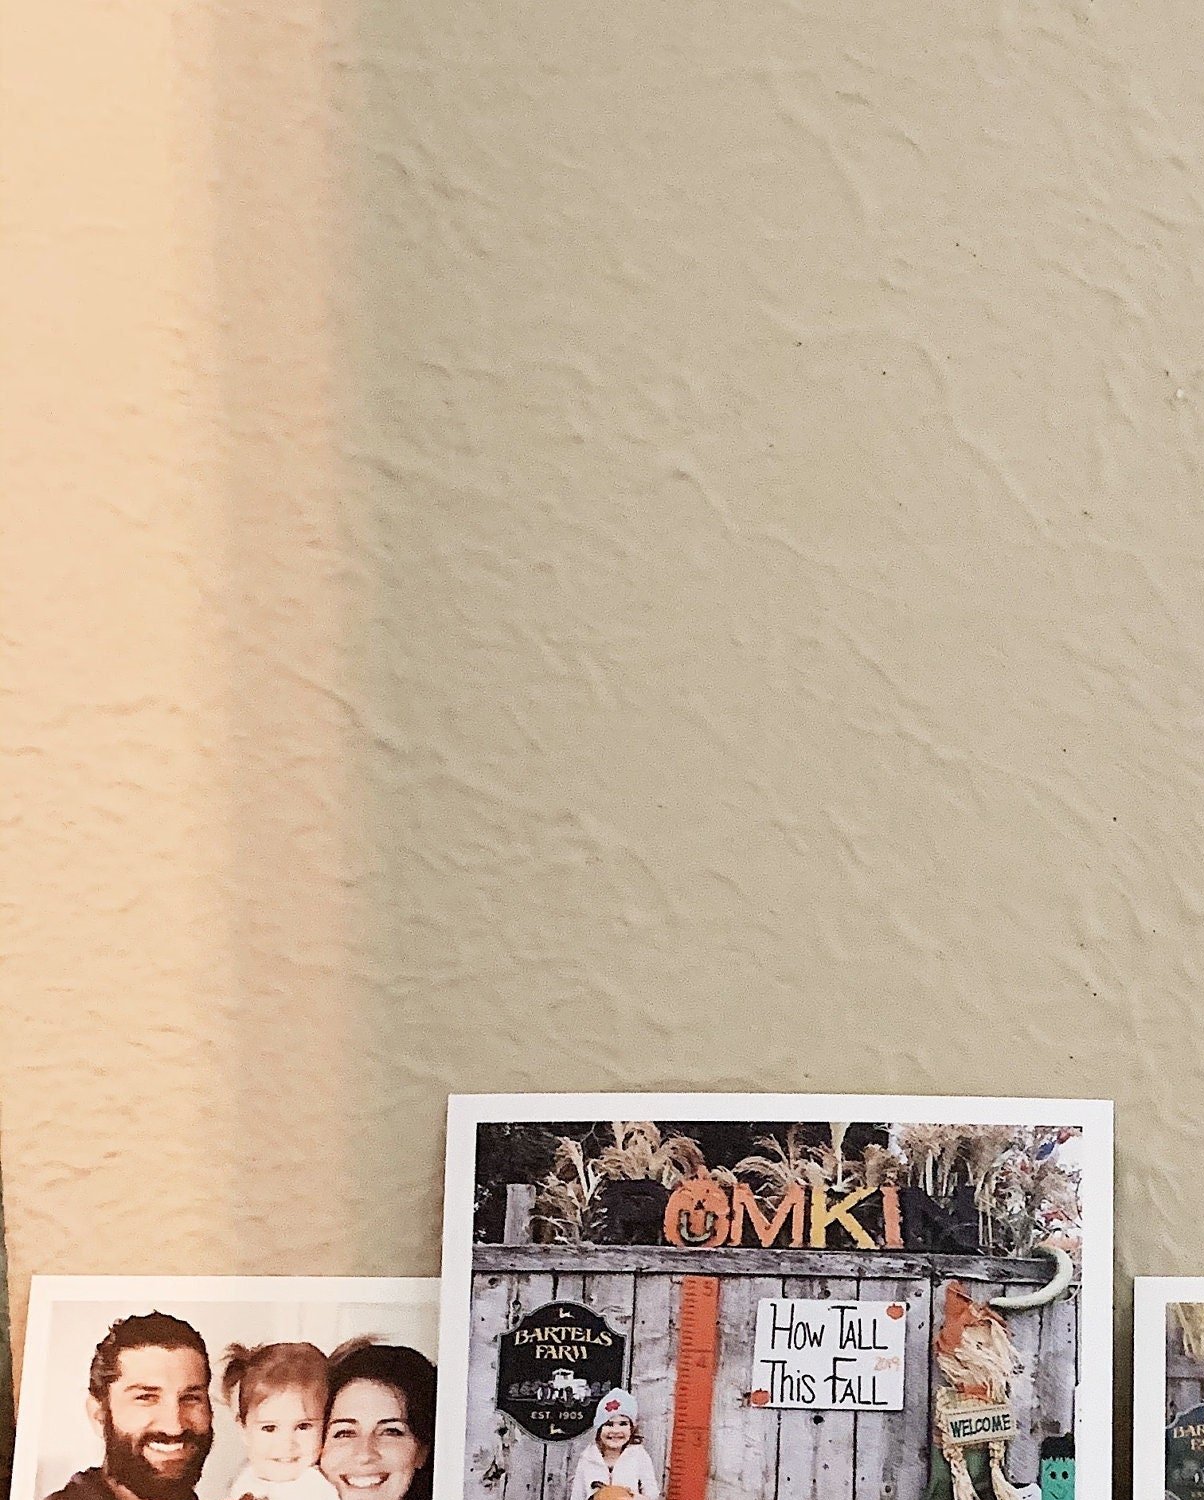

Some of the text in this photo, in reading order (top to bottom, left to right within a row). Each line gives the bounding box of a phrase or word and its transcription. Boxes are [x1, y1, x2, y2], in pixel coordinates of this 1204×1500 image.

[514, 1326, 613, 1347] BARTELS
[769, 1303, 889, 1351] How TALL
[535, 1345, 589, 1363] FARM
[760, 1356, 889, 1405] This FALL
[949, 1413, 1012, 1438] WELCOME
